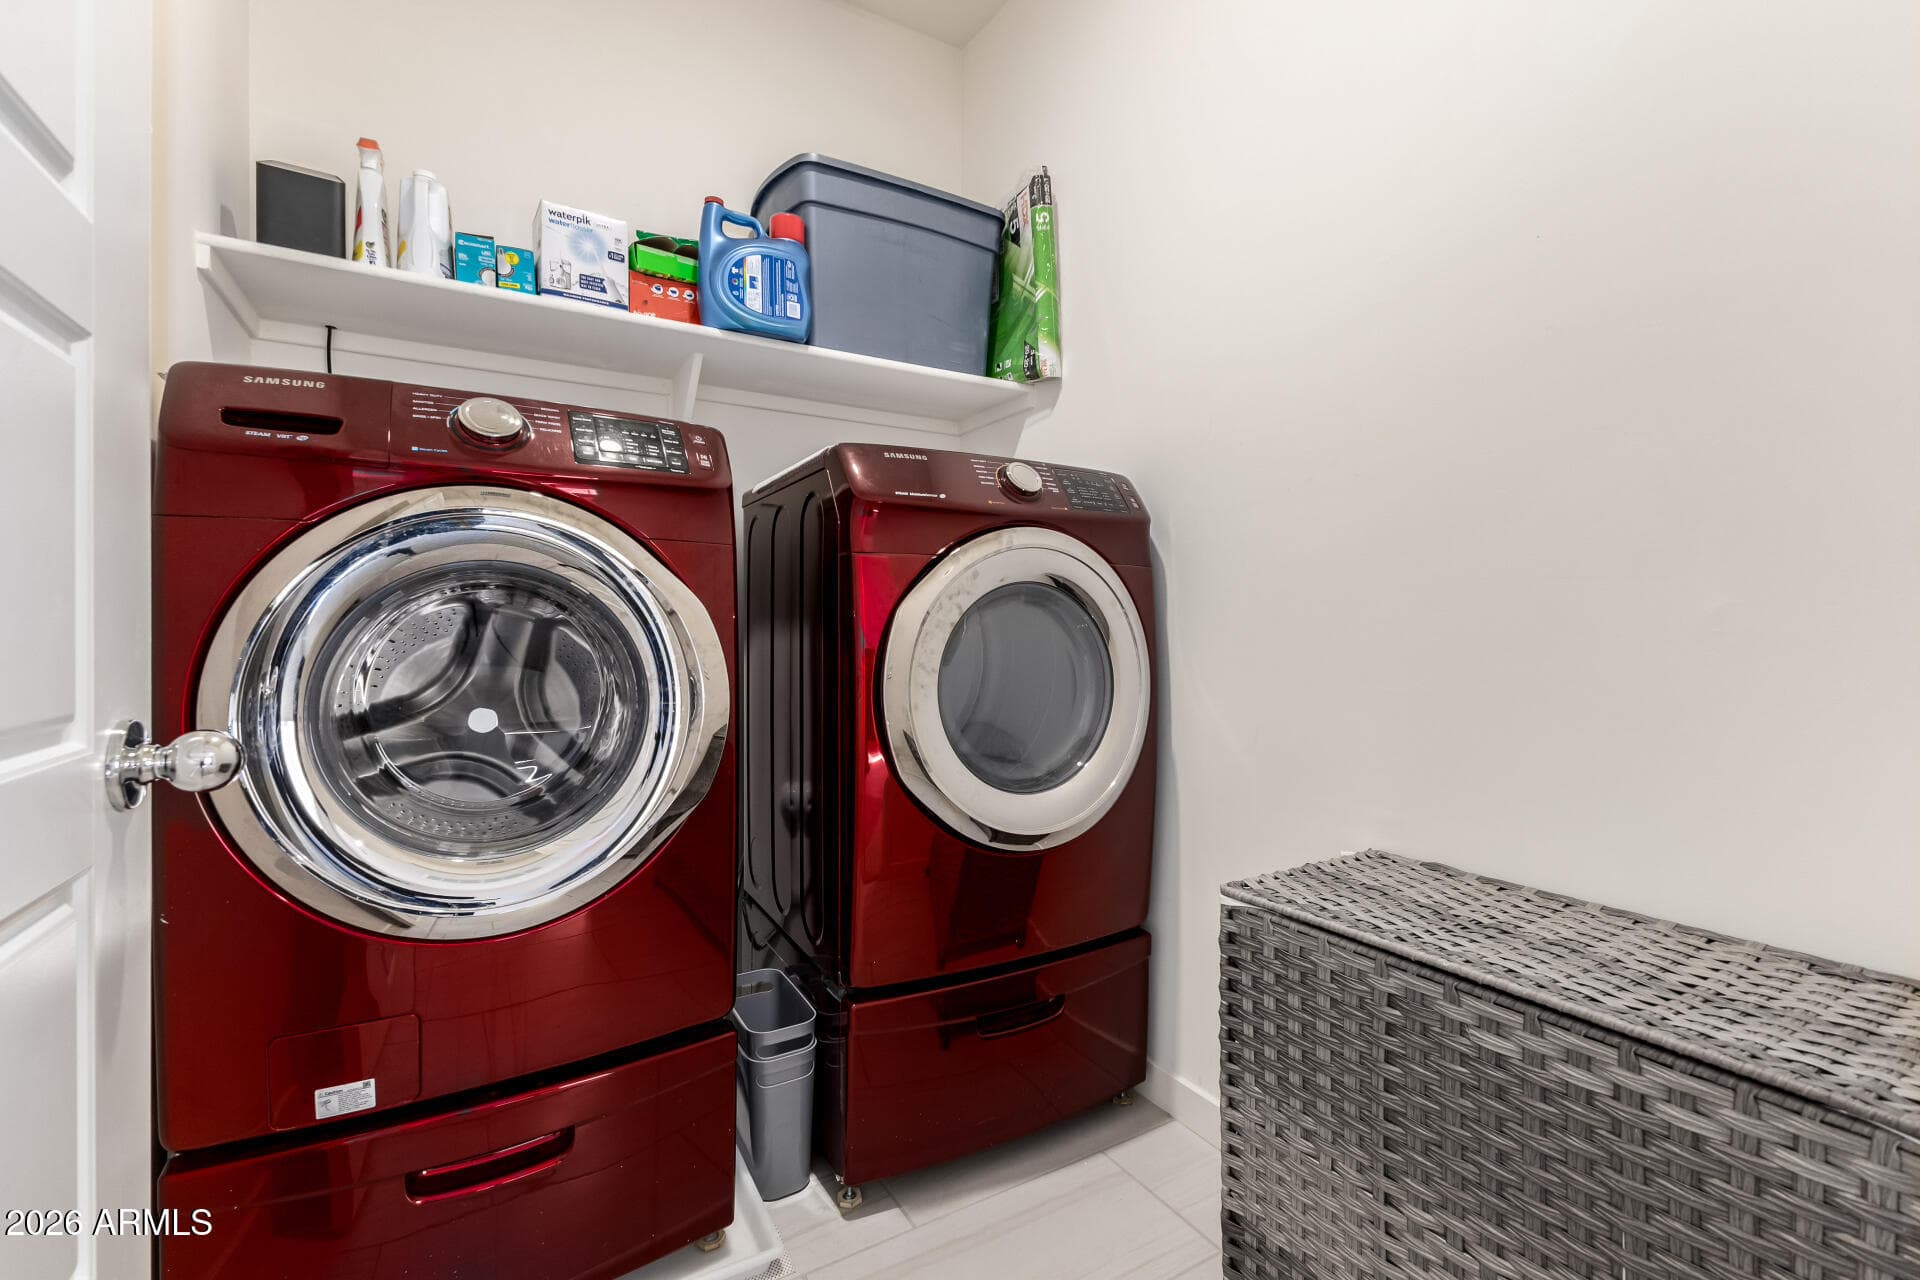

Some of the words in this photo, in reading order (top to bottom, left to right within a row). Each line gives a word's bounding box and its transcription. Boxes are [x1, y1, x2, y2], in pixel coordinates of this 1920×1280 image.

[548, 208, 591, 225] waterpik
[1009, 218, 1019, 234] 5
[243, 375, 326, 389] SAMSUNG
[244, 430, 272, 438] STEAM
[884, 452, 928, 461] SAMSUNG
